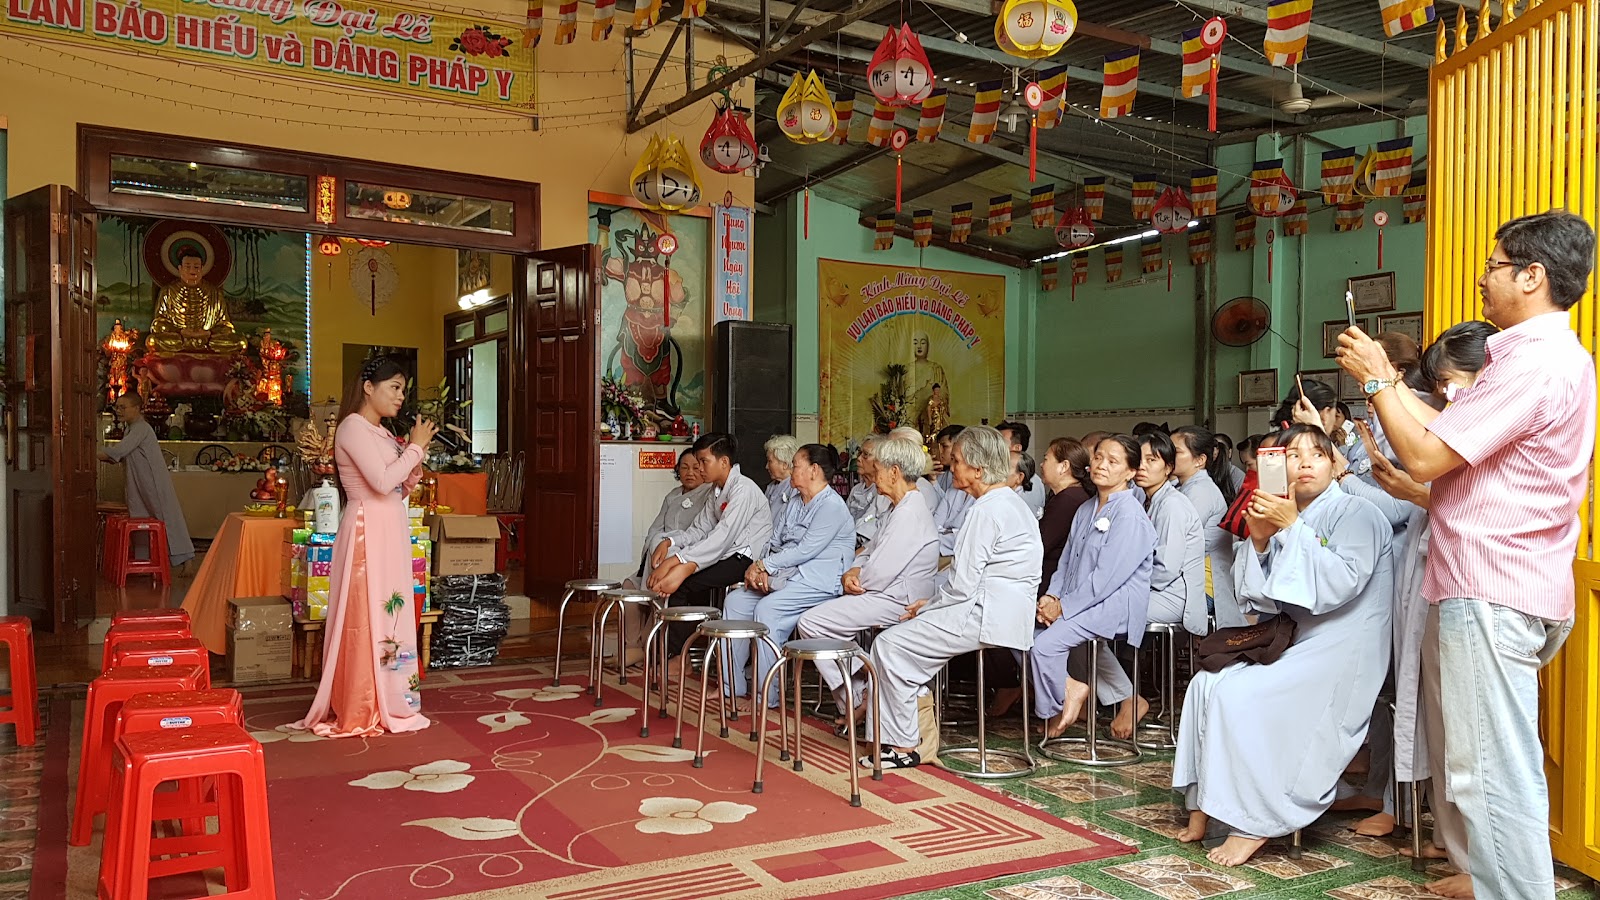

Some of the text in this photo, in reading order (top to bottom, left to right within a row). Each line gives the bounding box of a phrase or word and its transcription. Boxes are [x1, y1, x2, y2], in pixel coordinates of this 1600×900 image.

[303, 0, 377, 35] Đại
[382, 13, 432, 41] Lễ
[94, 0, 167, 42] BÁO
[176, 14, 257, 57] HIẾU
[264, 32, 303, 64] và
[313, 37, 398, 80] DÂNG
[409, 56, 487, 93] PHÁP
[494, 69, 513, 98] Y
[725, 279, 741, 299] Hội
[861, 275, 891, 303] Kính
[846, 291, 981, 347] VU LAN BÁO HIẾU và DÂNG PHÁP Y
